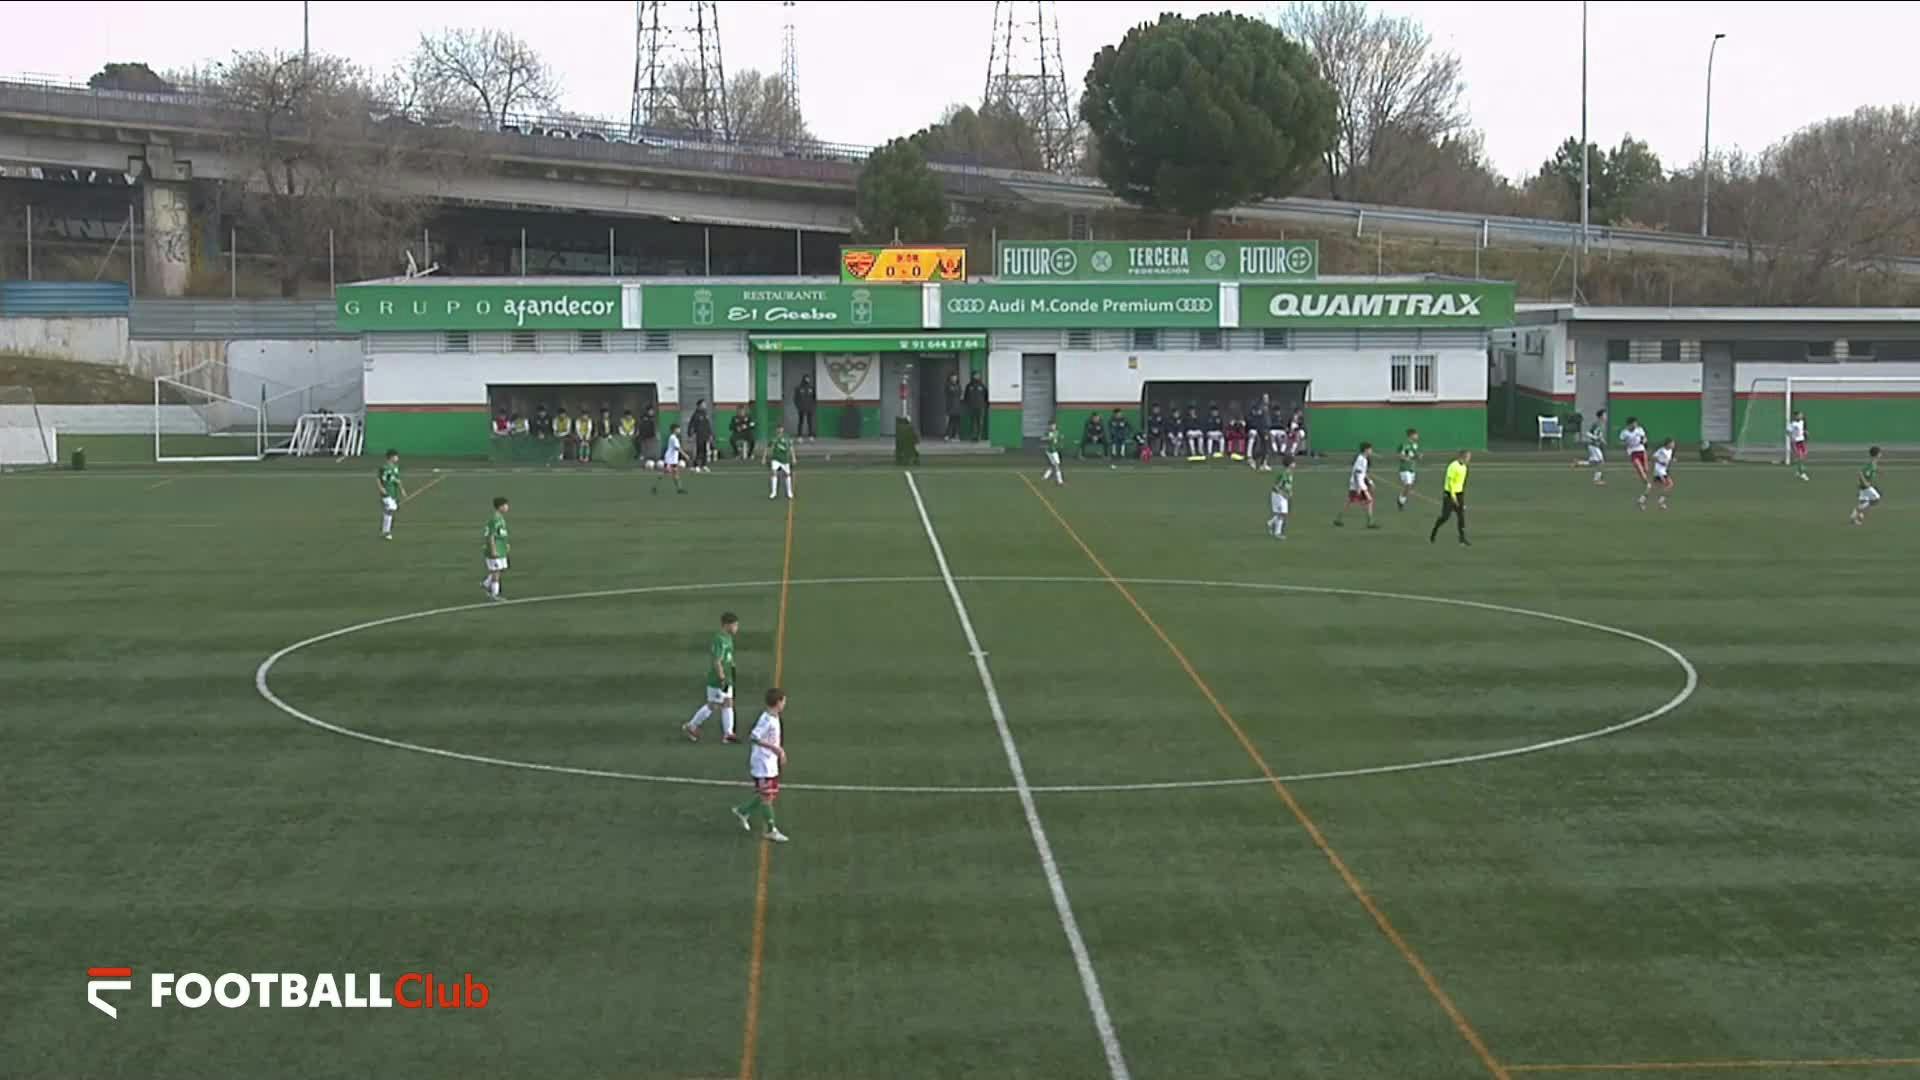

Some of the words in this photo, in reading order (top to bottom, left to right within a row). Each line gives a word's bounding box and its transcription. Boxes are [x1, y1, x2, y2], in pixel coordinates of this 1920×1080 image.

[1128, 247, 1189, 266] TERCERA
[886, 266, 895, 277] 0
[912, 265, 921, 277] 0
[743, 291, 825, 300] RESTAURANTE
[344, 299, 491, 316] GRUPO
[503, 296, 615, 326] afandecor
[988, 298, 1025, 313] Audi
[1031, 298, 1098, 313] M.Conde
[1103, 298, 1174, 313] Premium
[1269, 293, 1483, 316] QUAMTRAX
[727, 306, 757, 321] El
[764, 307, 837, 322] Acebo
[911, 340, 925, 349] 91
[950, 340, 963, 349] 17
